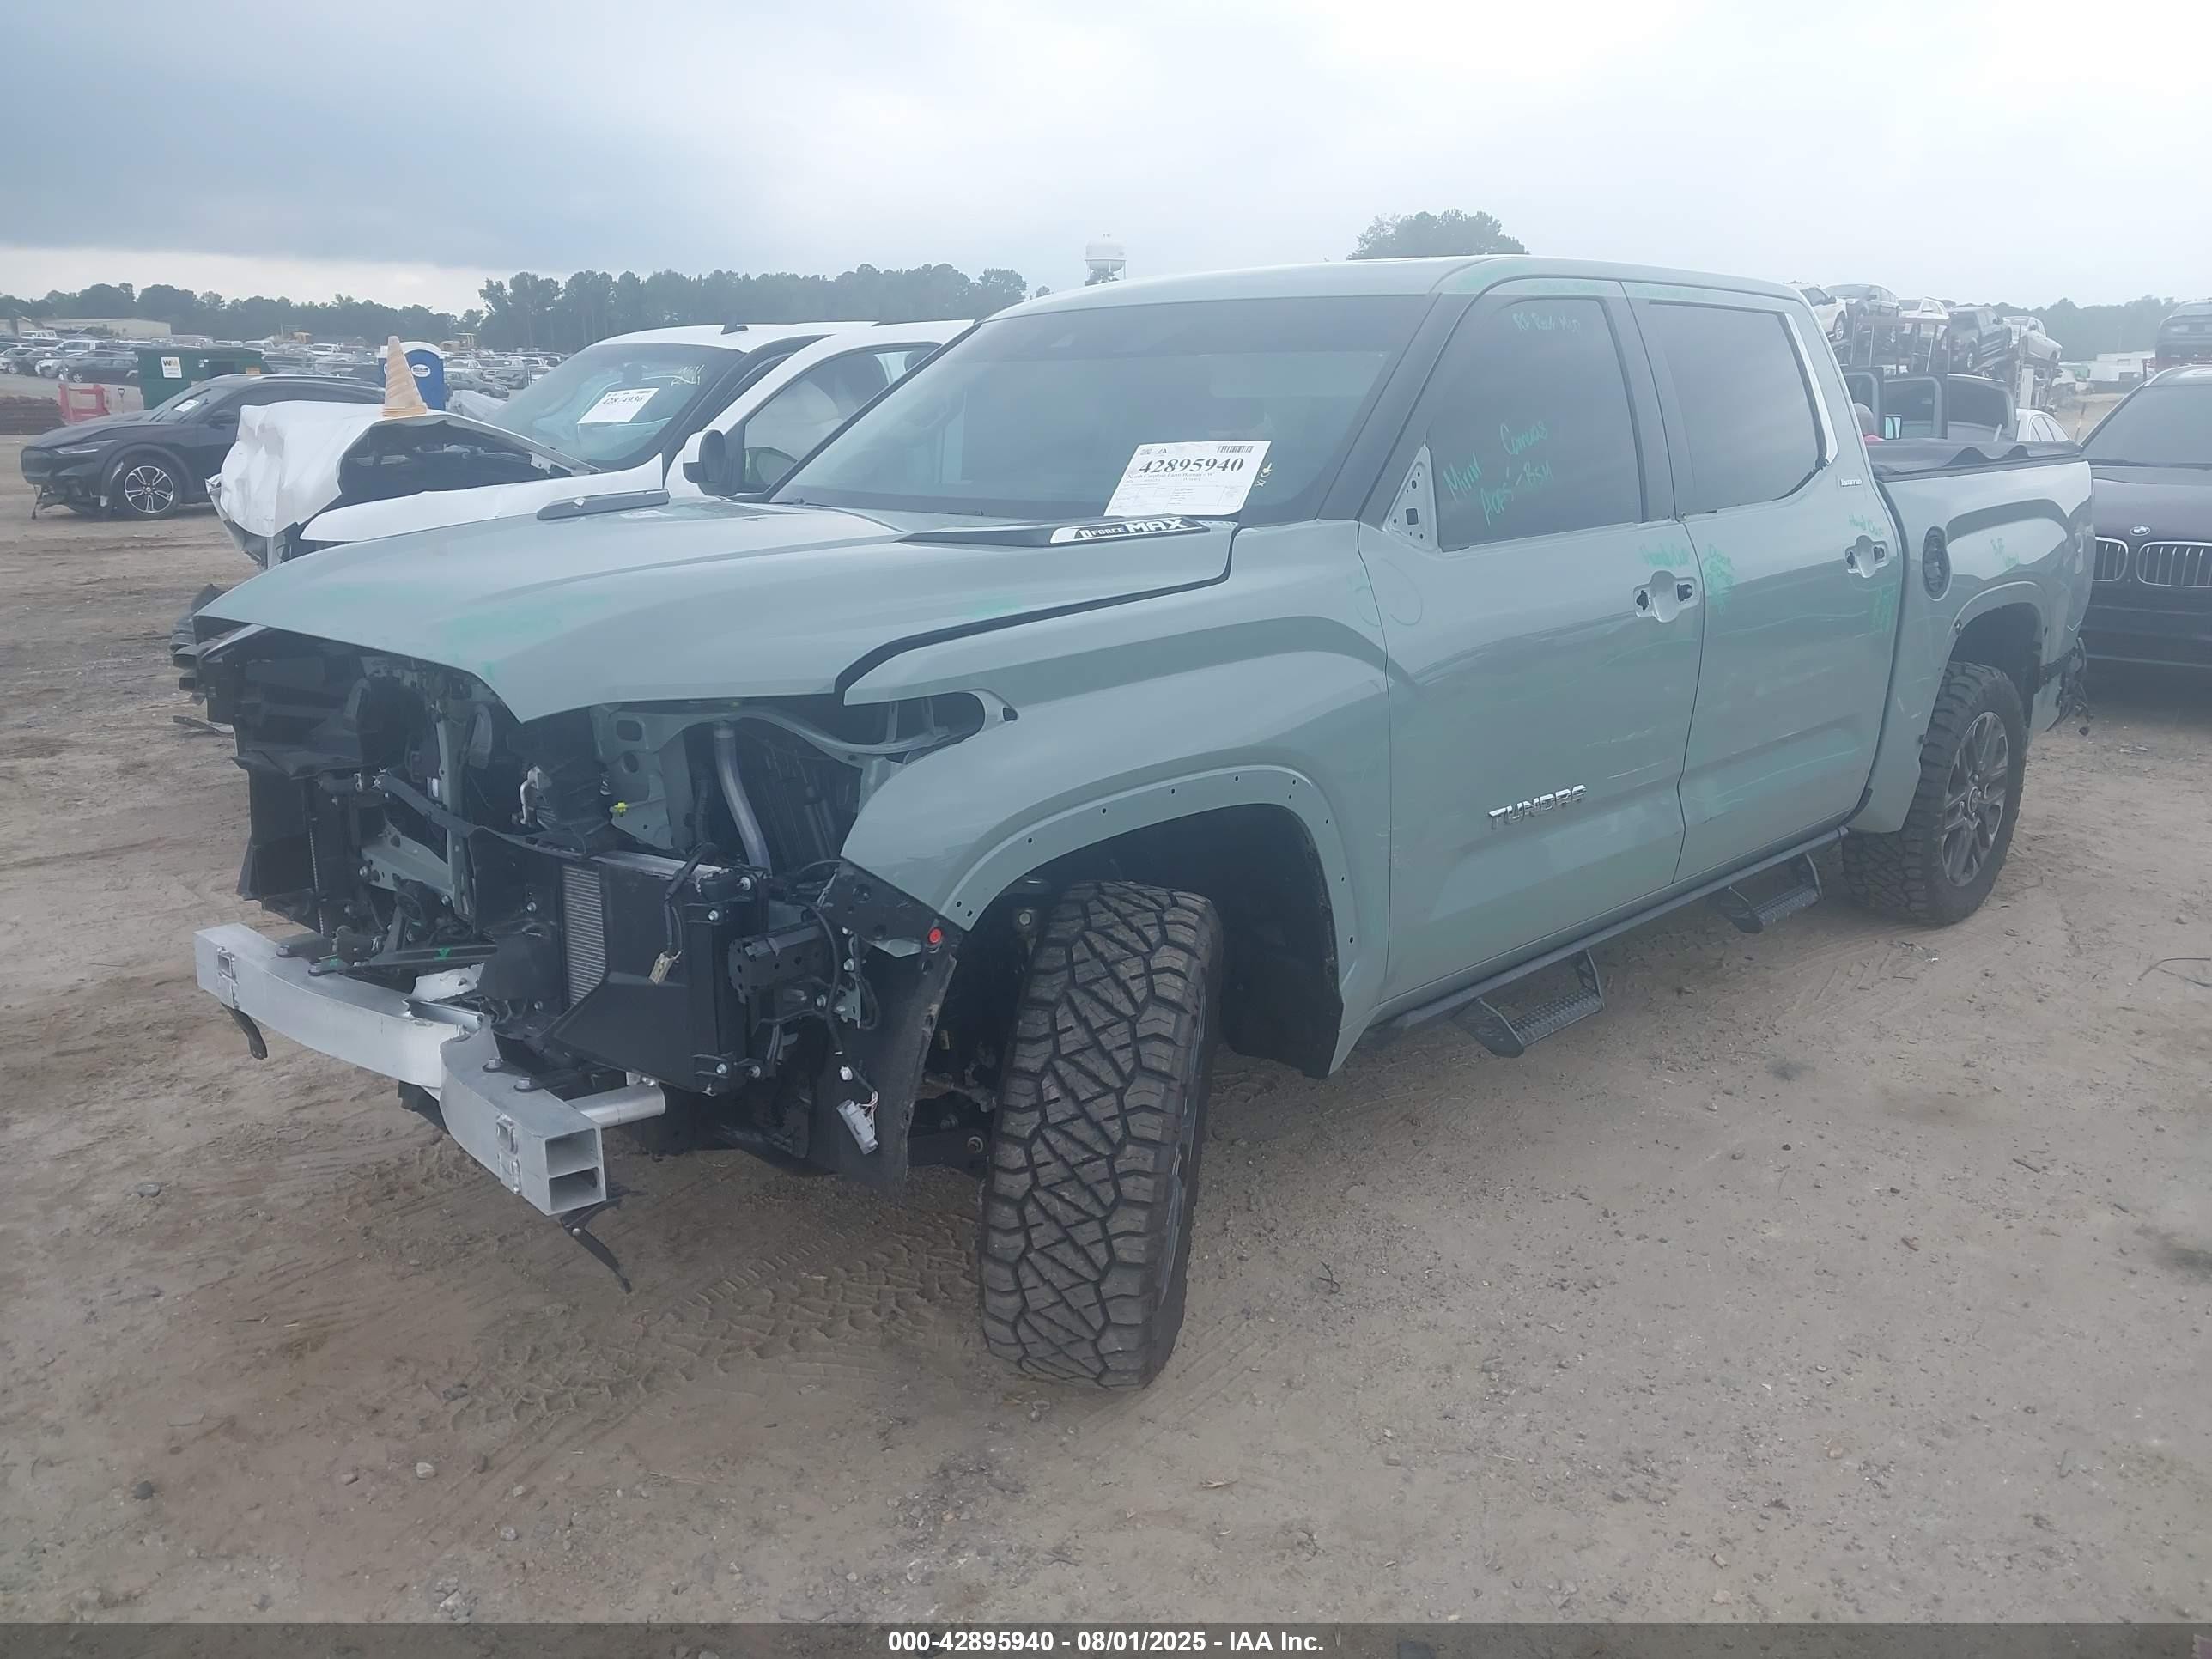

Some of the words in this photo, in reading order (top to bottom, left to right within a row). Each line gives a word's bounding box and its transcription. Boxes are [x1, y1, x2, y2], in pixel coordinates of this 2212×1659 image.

[1139, 457, 1245, 474] 42895940
[1125, 519, 1188, 533] MAX
[1488, 784, 1587, 830] TUNDRA
